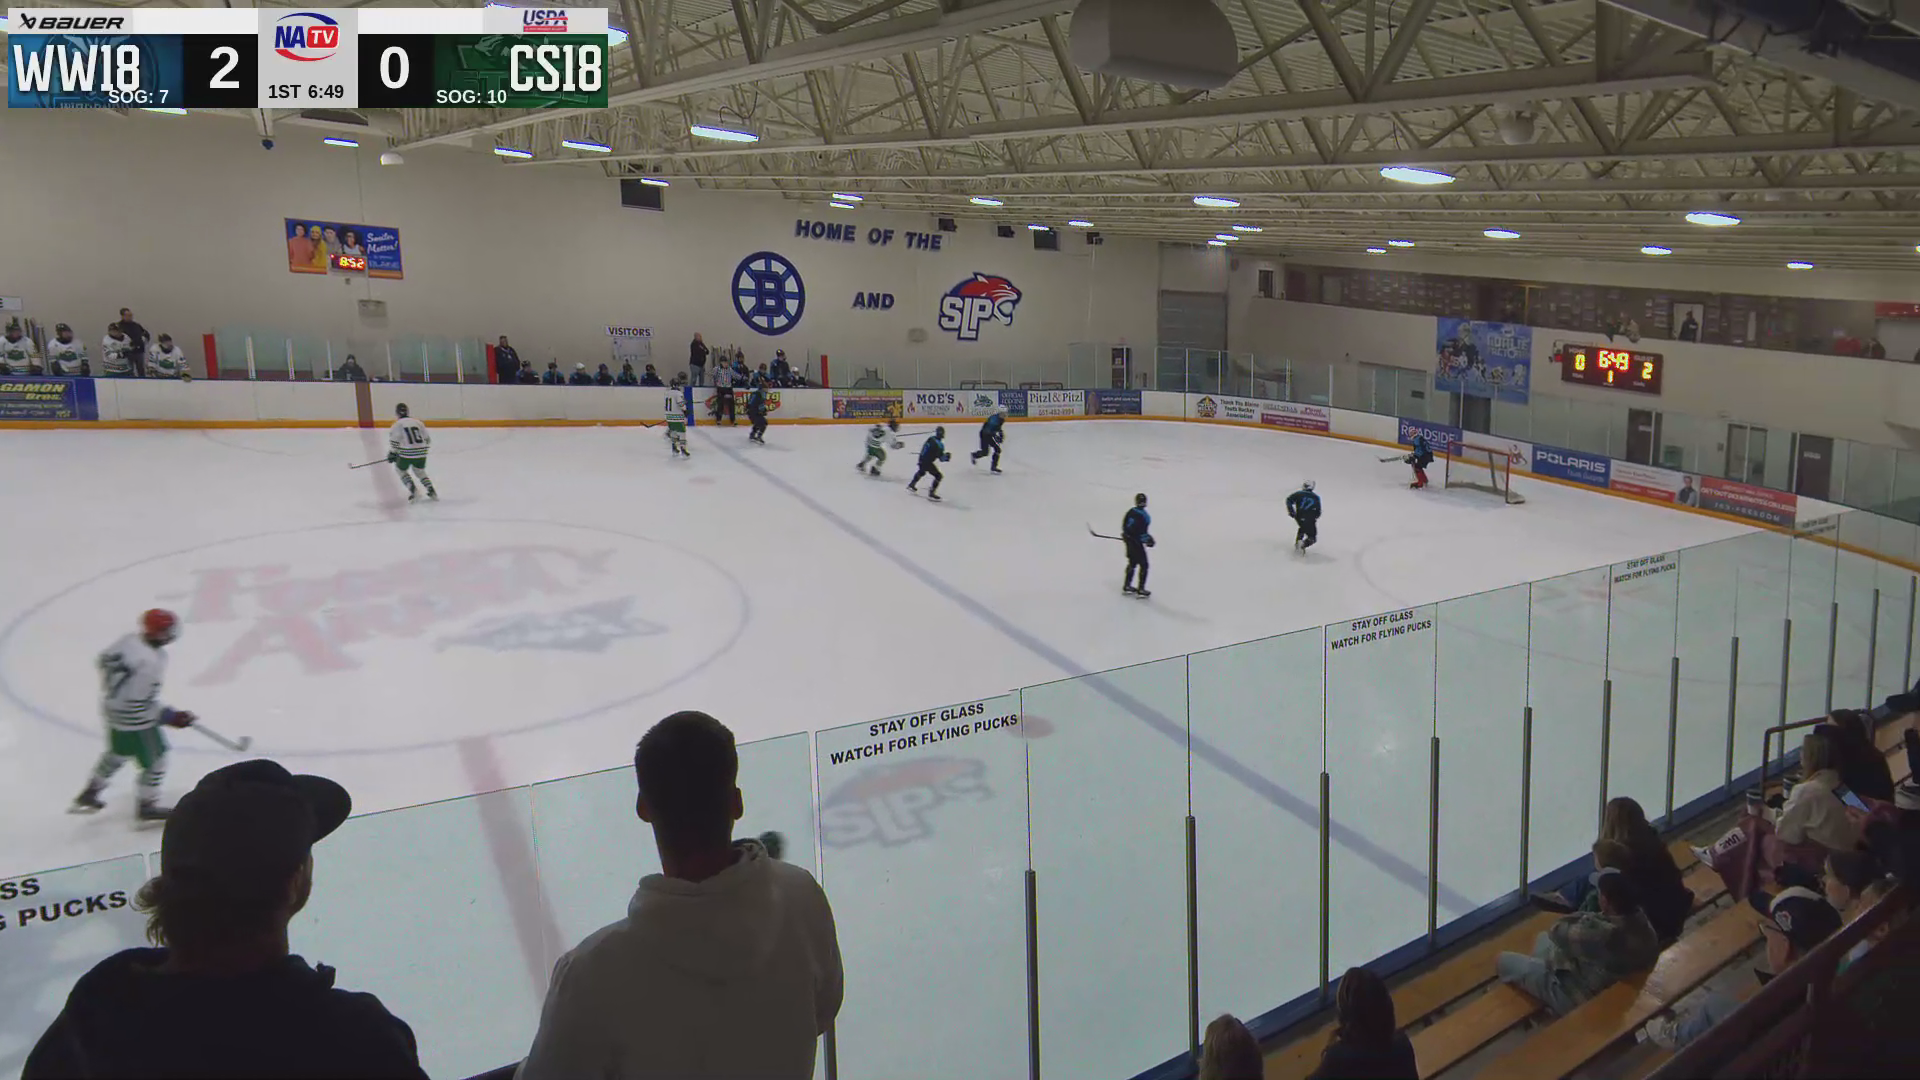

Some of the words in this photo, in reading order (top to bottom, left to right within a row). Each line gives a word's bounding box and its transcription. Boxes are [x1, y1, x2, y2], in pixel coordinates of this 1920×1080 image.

[795, 219, 856, 242] HOME
[868, 227, 894, 246] OF
[906, 231, 943, 250] THE
[755, 270, 787, 317] B
[852, 291, 895, 309] AND
[938, 293, 994, 341] SLP
[608, 326, 651, 337] VISITORS
[1575, 354, 1586, 371] 0
[1599, 350, 1630, 371] 6:49
[1641, 361, 1653, 380] 2
[1607, 369, 1614, 383] 1
[0, 383, 65, 392] GAMON
[1030, 392, 1051, 403] Pitzl
[1052, 391, 1060, 403] &
[1062, 391, 1083, 403] Pitzl
[665, 397, 673, 411] 11
[916, 392, 955, 405] MOE'S
[403, 426, 423, 445] 10
[1536, 451, 1606, 473] POLARIS
[1352, 621, 1371, 631] STAY
[1373, 616, 1388, 626] OFF
[1389, 610, 1413, 623] GLASS
[1331, 636, 1359, 650] WATCH
[1361, 632, 1377, 643] FOR
[1378, 626, 1405, 639] FLYING
[1407, 620, 1432, 632] PUCKS
[869, 719, 906, 737] STAY
[909, 712, 937, 728] OFF
[940, 703, 985, 721] GLASS
[830, 743, 884, 765] WATCH
[889, 736, 917, 752] FOR
[921, 724, 970, 745] FLYING
[974, 713, 1018, 733] PUCKS
[18, 891, 127, 927] PUCKS
